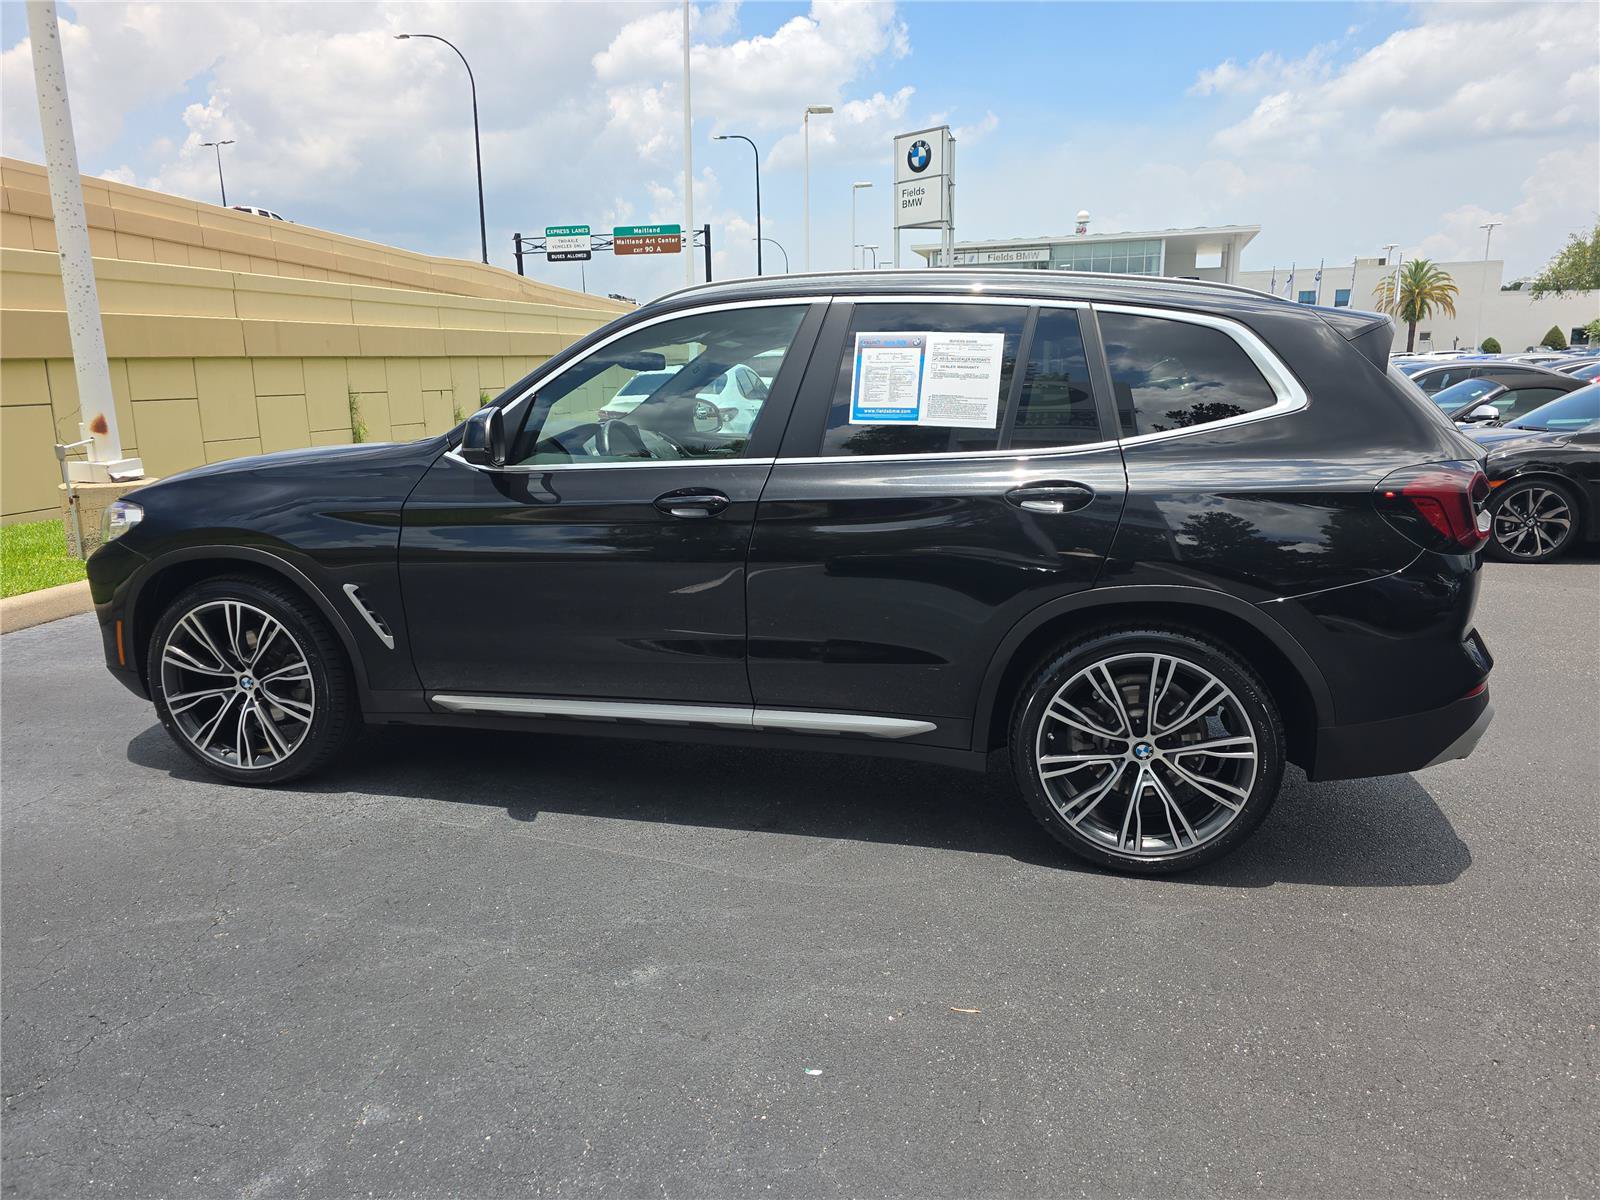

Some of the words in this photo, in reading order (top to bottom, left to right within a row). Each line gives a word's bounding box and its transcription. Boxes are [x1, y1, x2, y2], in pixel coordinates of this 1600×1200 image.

[902, 187, 925, 198] Fields
[902, 198, 923, 209] BMW
[987, 252, 1014, 262] Fields
[1015, 251, 1040, 261] BMW
